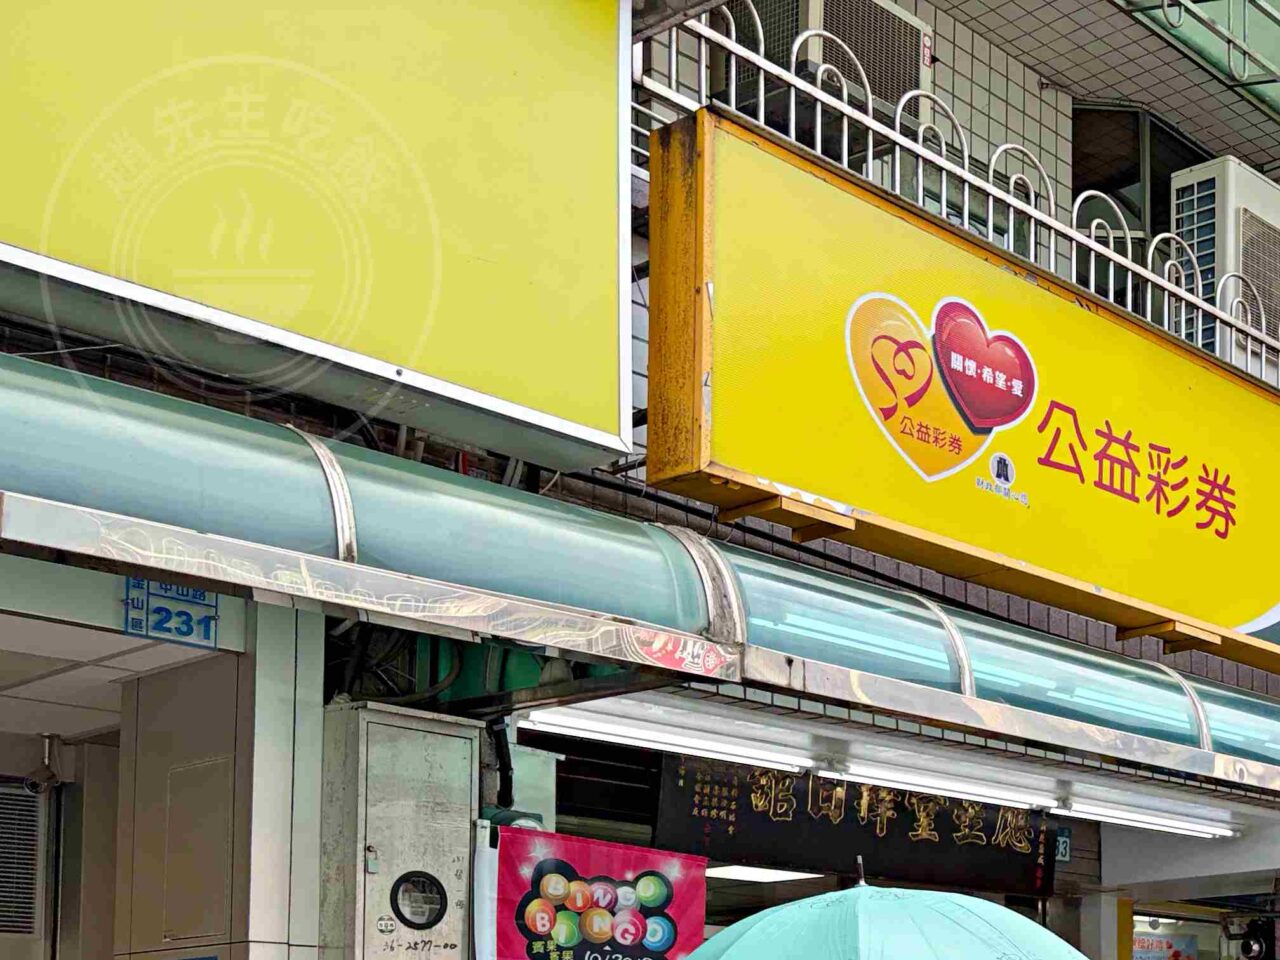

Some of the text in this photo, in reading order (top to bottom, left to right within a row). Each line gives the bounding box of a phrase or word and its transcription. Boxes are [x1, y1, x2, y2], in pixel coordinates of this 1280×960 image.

[900, 415, 963, 456] 公益彩券
[1036, 398, 1238, 540] 公益彩券
[151, 606, 211, 641] 231
[535, 911, 663, 945] BINGO
